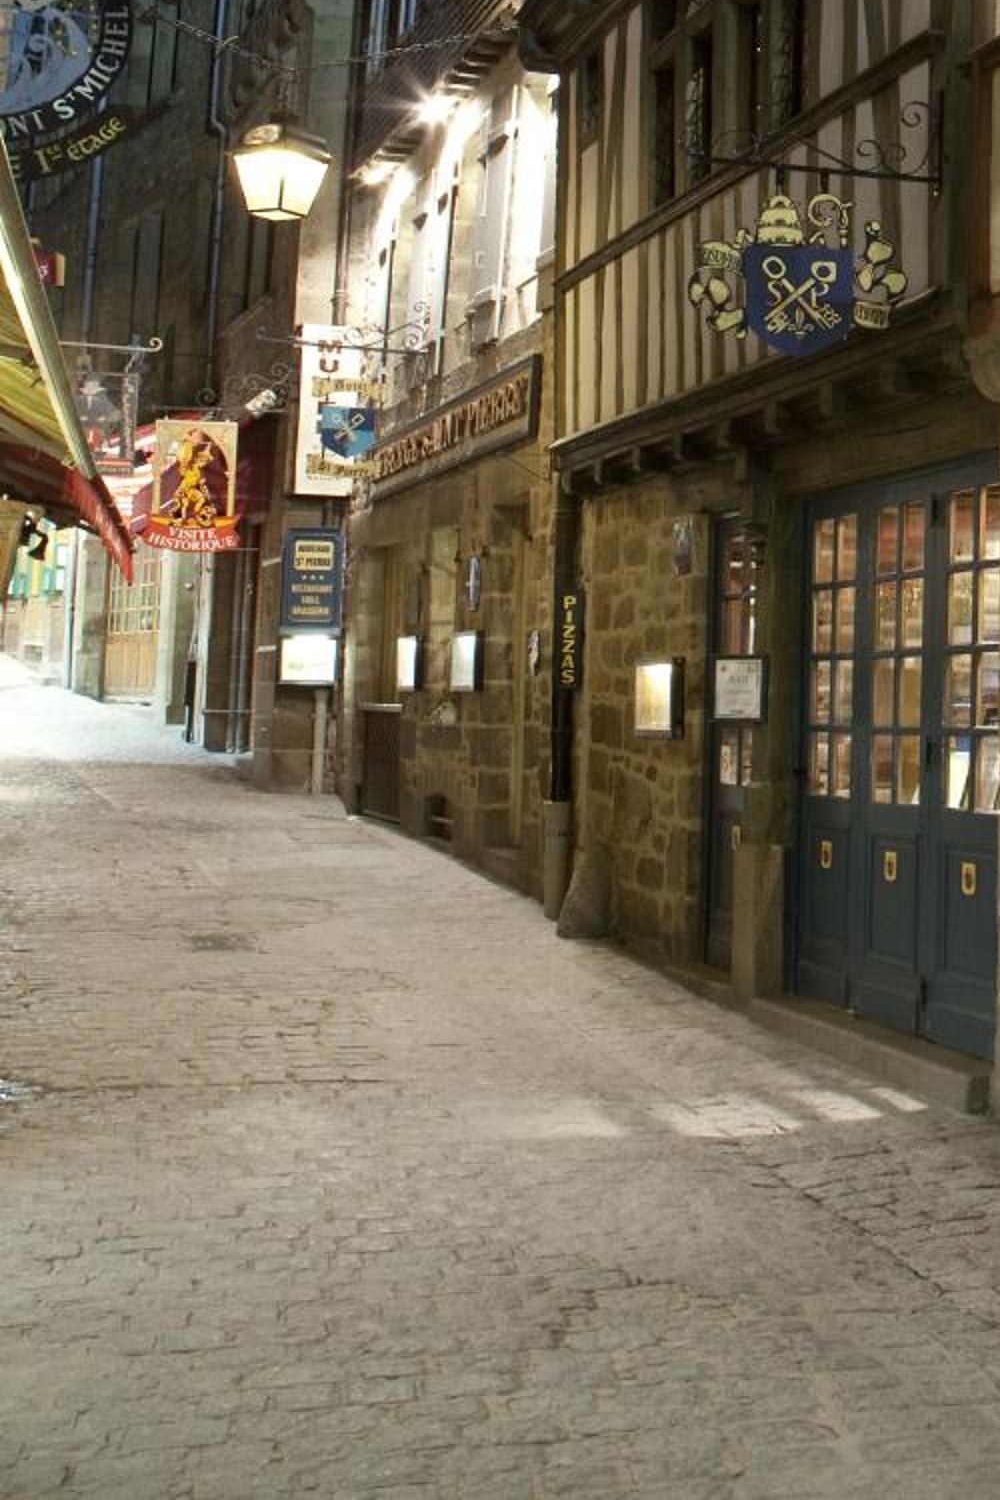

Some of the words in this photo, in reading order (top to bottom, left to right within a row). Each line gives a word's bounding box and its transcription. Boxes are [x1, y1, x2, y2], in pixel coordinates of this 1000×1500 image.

[74, 4, 129, 102] MICHEL
[149, 533, 234, 551] HISTORIQUE
[169, 526, 216, 540] VISITE
[561, 595, 577, 685] PIZZAS
